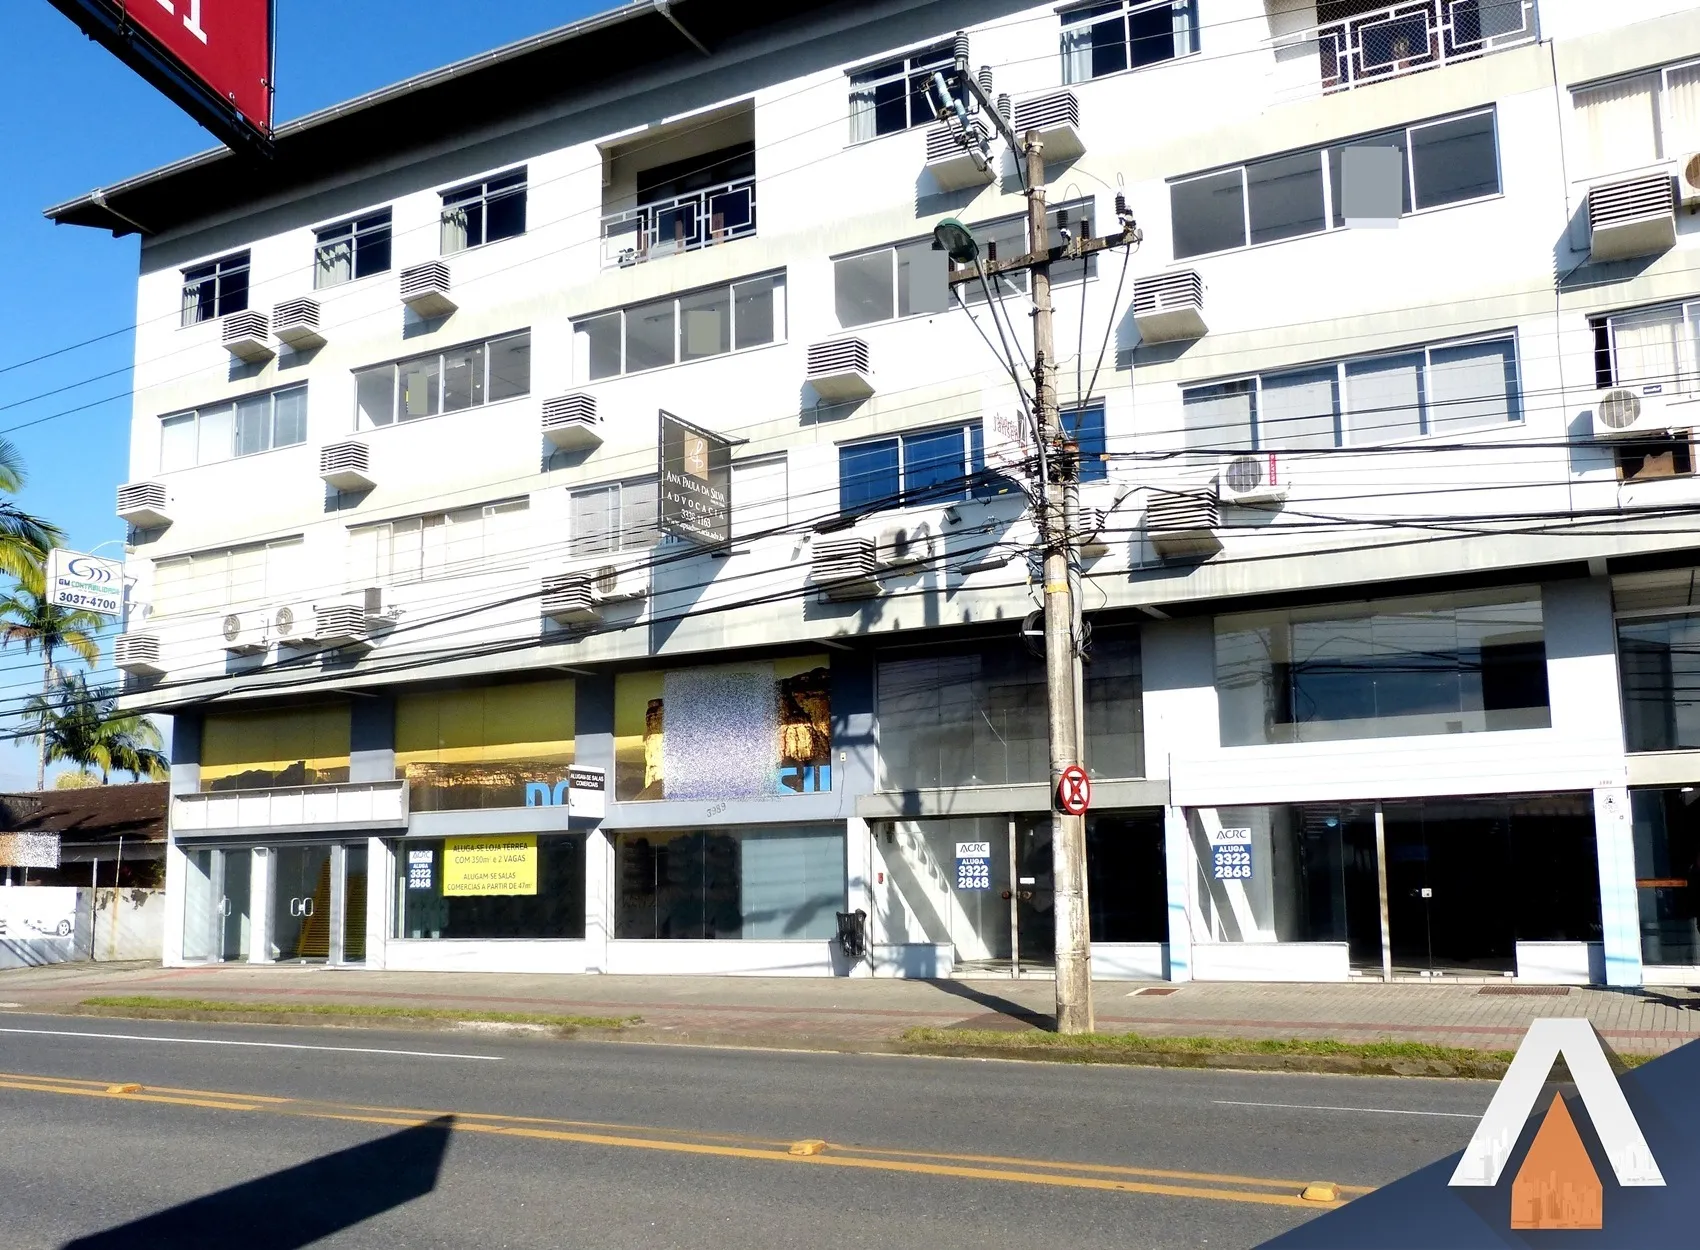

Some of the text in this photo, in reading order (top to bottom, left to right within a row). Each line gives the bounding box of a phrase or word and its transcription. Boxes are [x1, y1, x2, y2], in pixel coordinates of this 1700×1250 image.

[666, 471, 725, 502] ANA PAULA DA SILVA
[59, 592, 116, 610] 3037-4700
[706, 802, 727, 818] 3989
[1216, 829, 1247, 840] ACRC
[453, 844, 485, 852] ALUGA-SE
[485, 843, 501, 852] LOJA
[960, 843, 986, 853] ACRC
[1219, 845, 1245, 853] ALUGA
[454, 856, 471, 864] COM
[503, 854, 526, 863] VAGAS
[1215, 853, 1250, 865] 3322
[410, 869, 431, 878] 3322
[958, 865, 989, 876] 3322
[1215, 865, 1251, 878] 2868
[410, 878, 431, 888] 2868
[508, 882, 517, 890] DE
[958, 877, 989, 888] 2868
